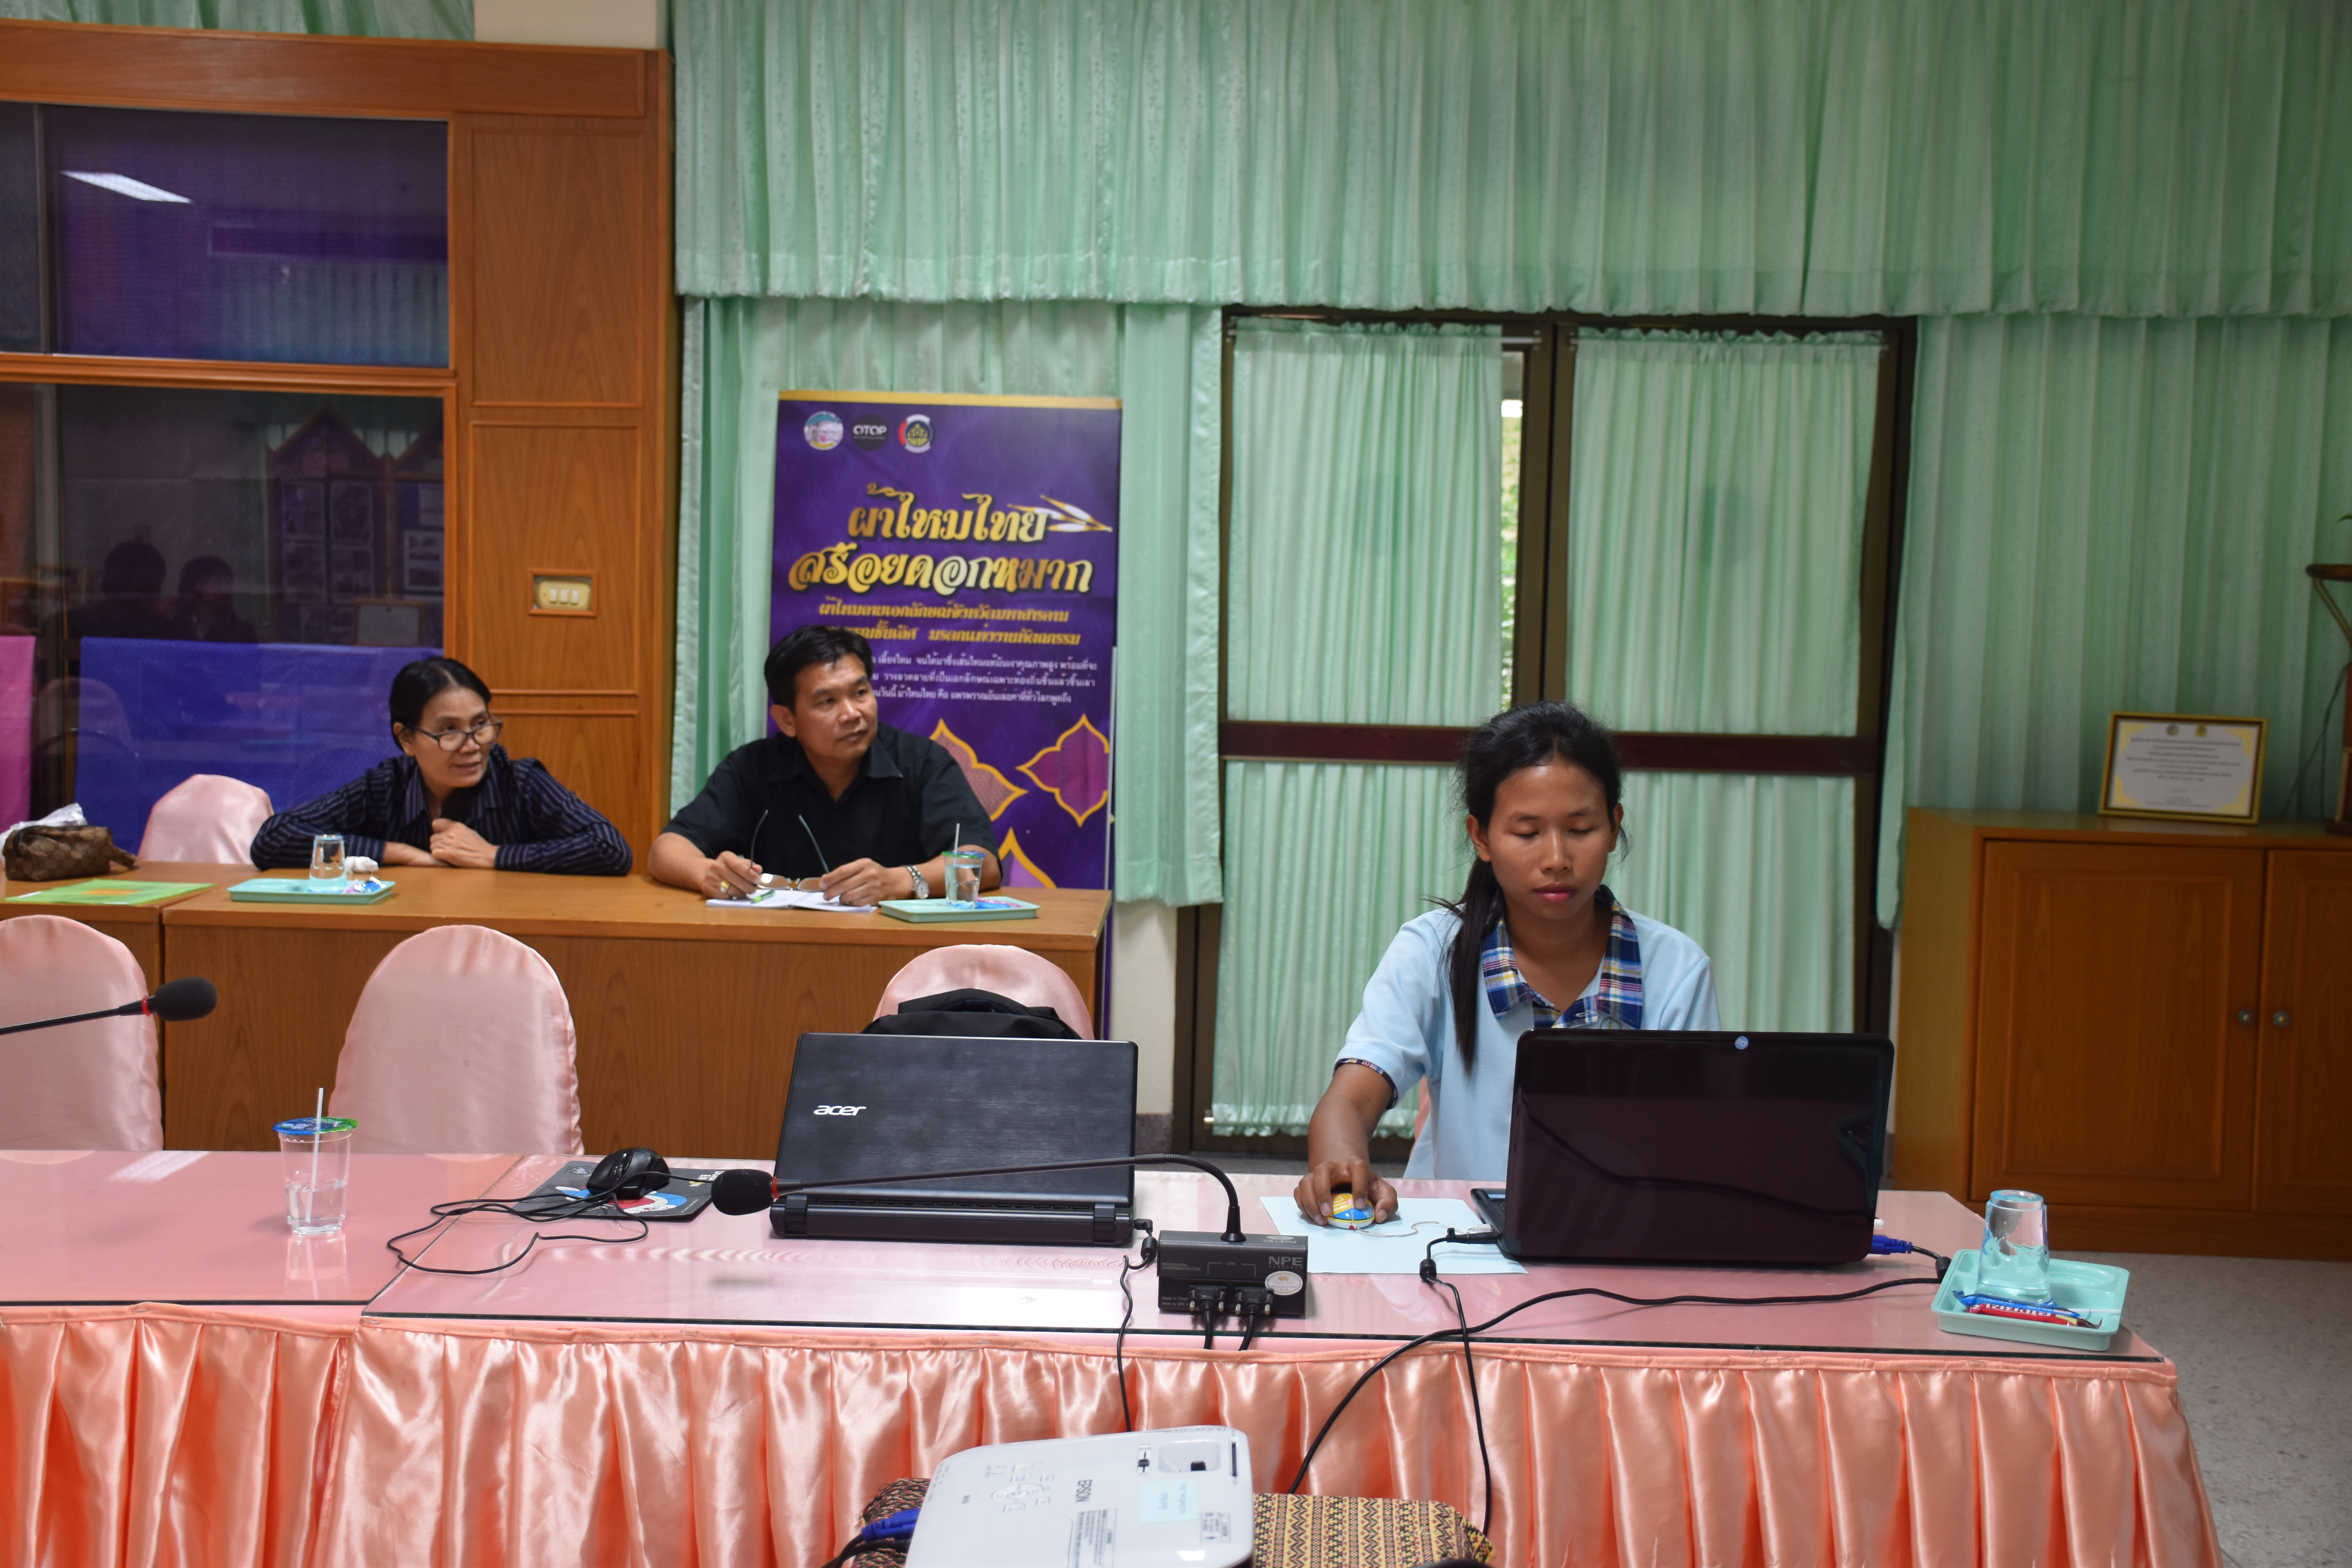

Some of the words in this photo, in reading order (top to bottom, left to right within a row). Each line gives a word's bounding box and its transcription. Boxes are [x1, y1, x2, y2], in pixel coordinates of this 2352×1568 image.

[852, 424, 887, 436] OTOP
[847, 483, 1049, 543] ผ้าไหมไทย
[788, 542, 1093, 595] สร้อยดอกหมาก
[813, 1104, 866, 1116] acer
[1269, 1256, 1303, 1266] NPE
[1076, 1479, 1092, 1502] EPSON
